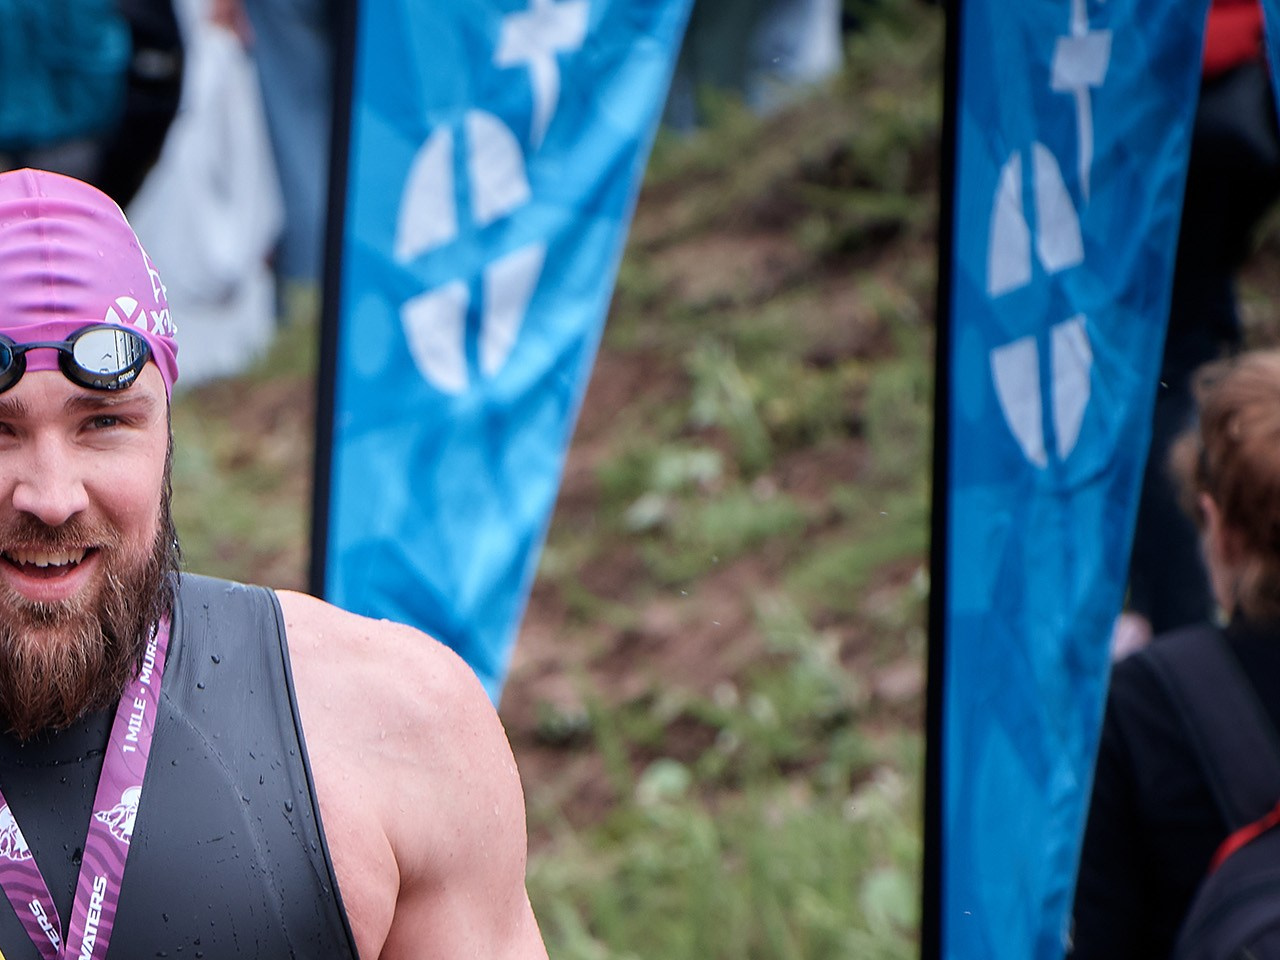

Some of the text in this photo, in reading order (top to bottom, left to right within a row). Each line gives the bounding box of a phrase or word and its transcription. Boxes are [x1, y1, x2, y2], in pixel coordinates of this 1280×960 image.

[122, 626, 158, 753] 1 MILE MUR
